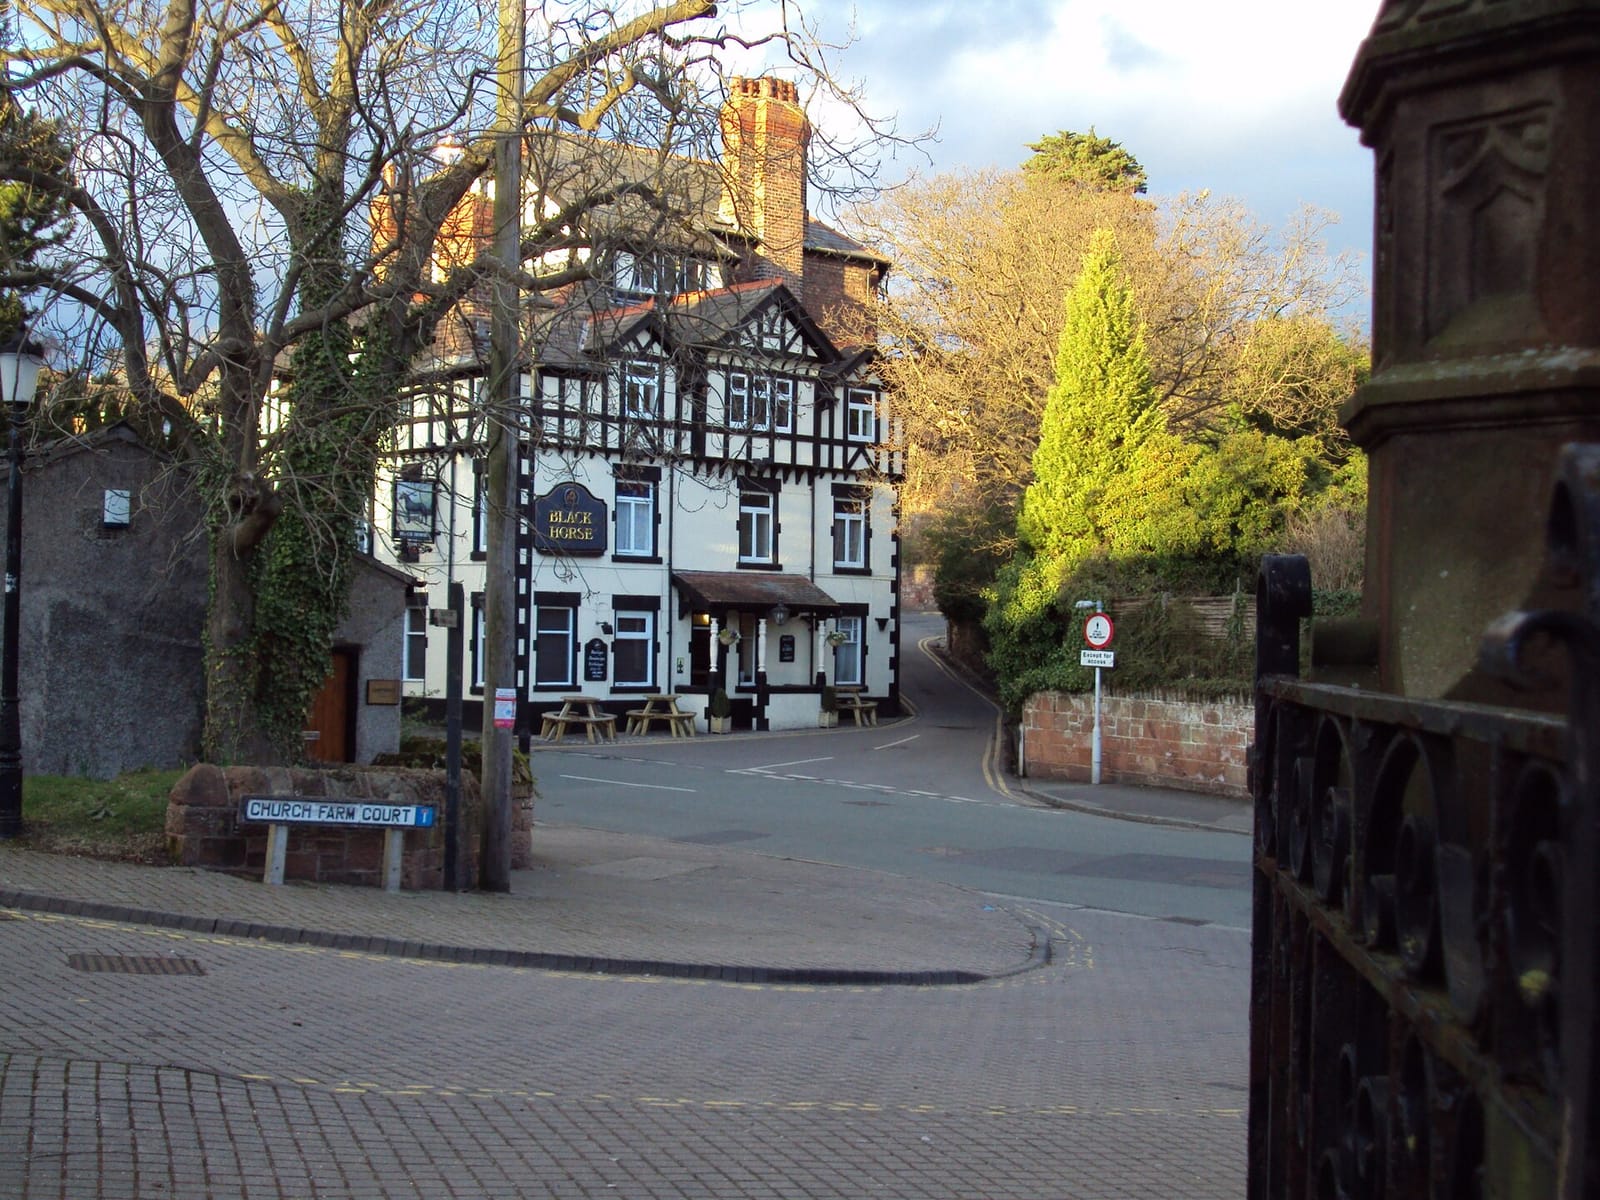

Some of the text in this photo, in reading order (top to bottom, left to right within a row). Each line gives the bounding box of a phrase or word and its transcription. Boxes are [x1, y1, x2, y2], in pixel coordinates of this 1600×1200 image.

[549, 511, 593, 525] BLACK
[549, 526, 594, 540] HORSE
[250, 802, 412, 823] CHURCH FARM COURT
